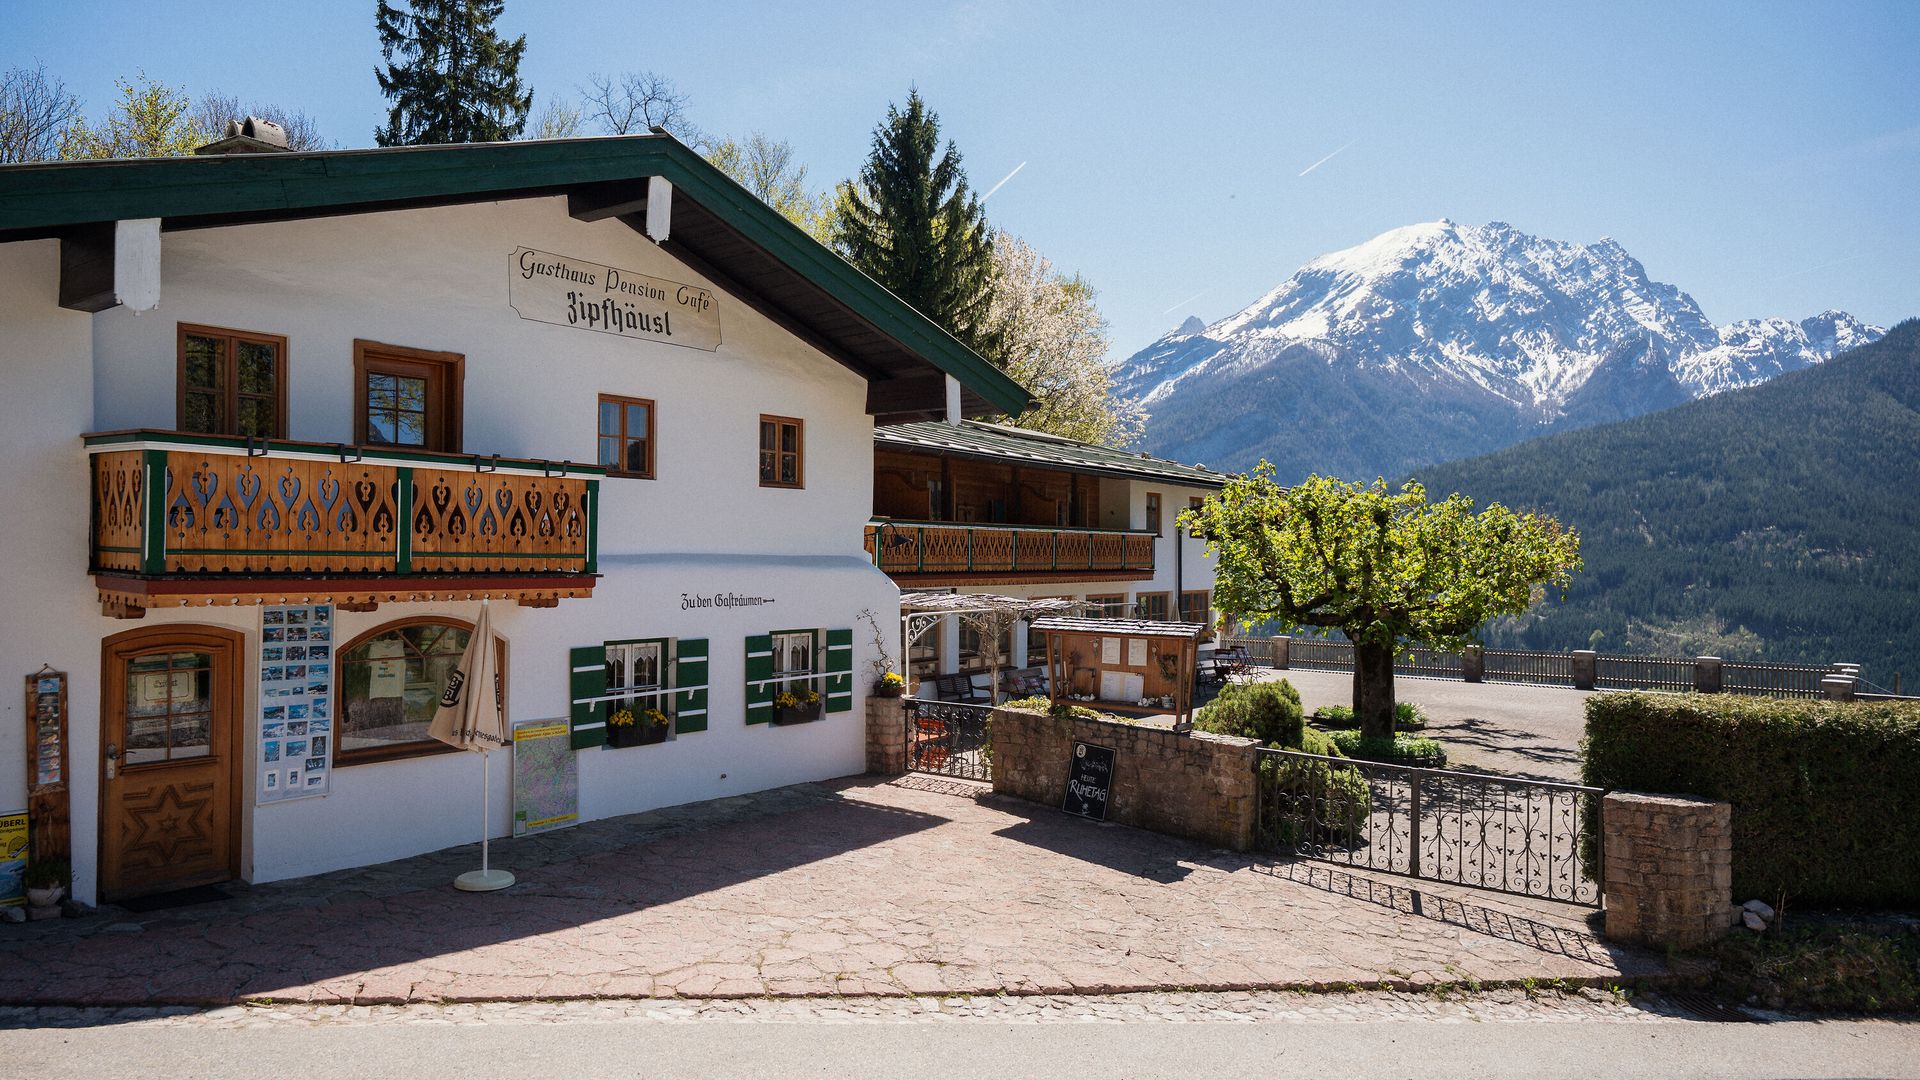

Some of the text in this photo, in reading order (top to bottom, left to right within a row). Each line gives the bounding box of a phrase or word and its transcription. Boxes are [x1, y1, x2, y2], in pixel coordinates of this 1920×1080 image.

[519, 250, 711, 313] Gasthaus Pension Café
[567, 290, 673, 336] Zipfhäusl
[681, 593, 696, 610] Zu
[697, 593, 712, 608] den
[1070, 779, 1107, 802] RUHETAG
